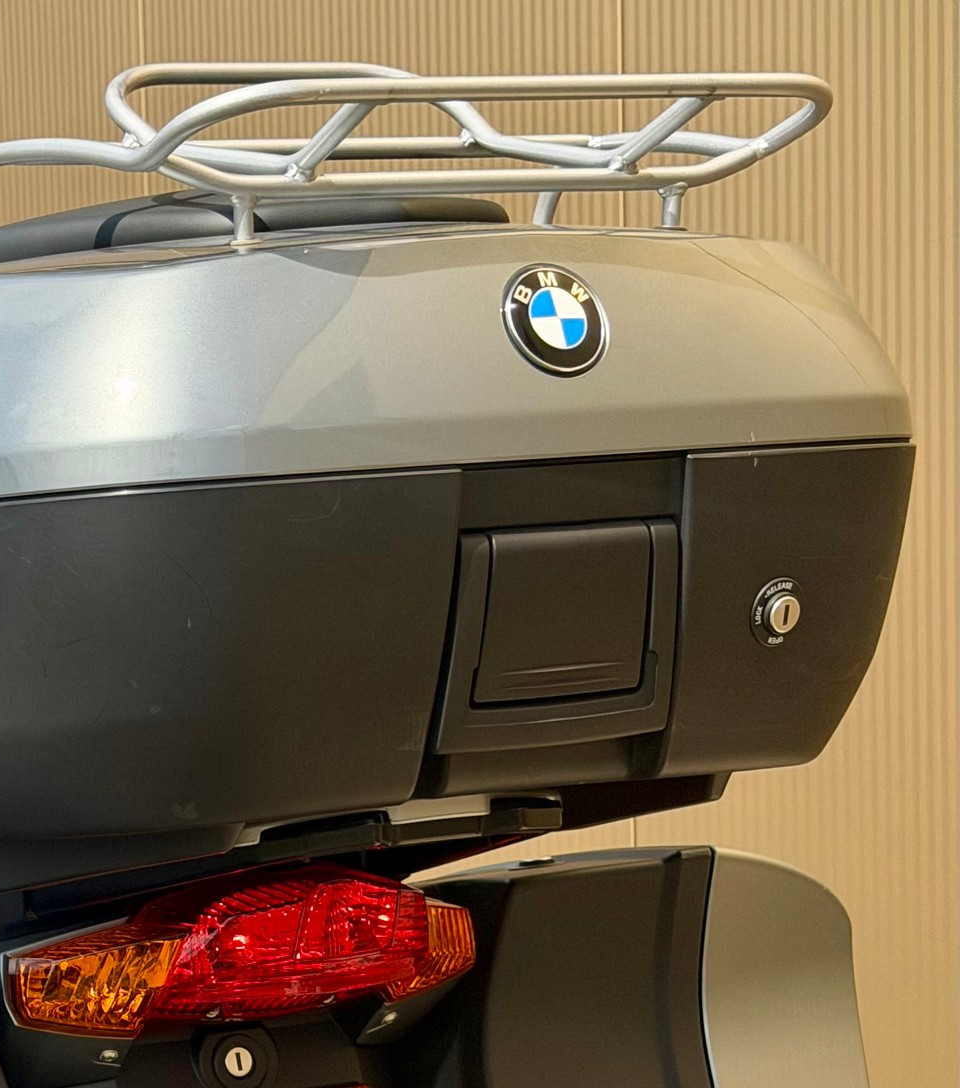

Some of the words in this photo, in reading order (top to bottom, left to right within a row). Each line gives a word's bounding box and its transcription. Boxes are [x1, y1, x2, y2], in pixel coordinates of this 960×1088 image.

[513, 271, 590, 304] BMW
[755, 605, 763, 625] LOCK
[767, 636, 784, 644] OPEN
